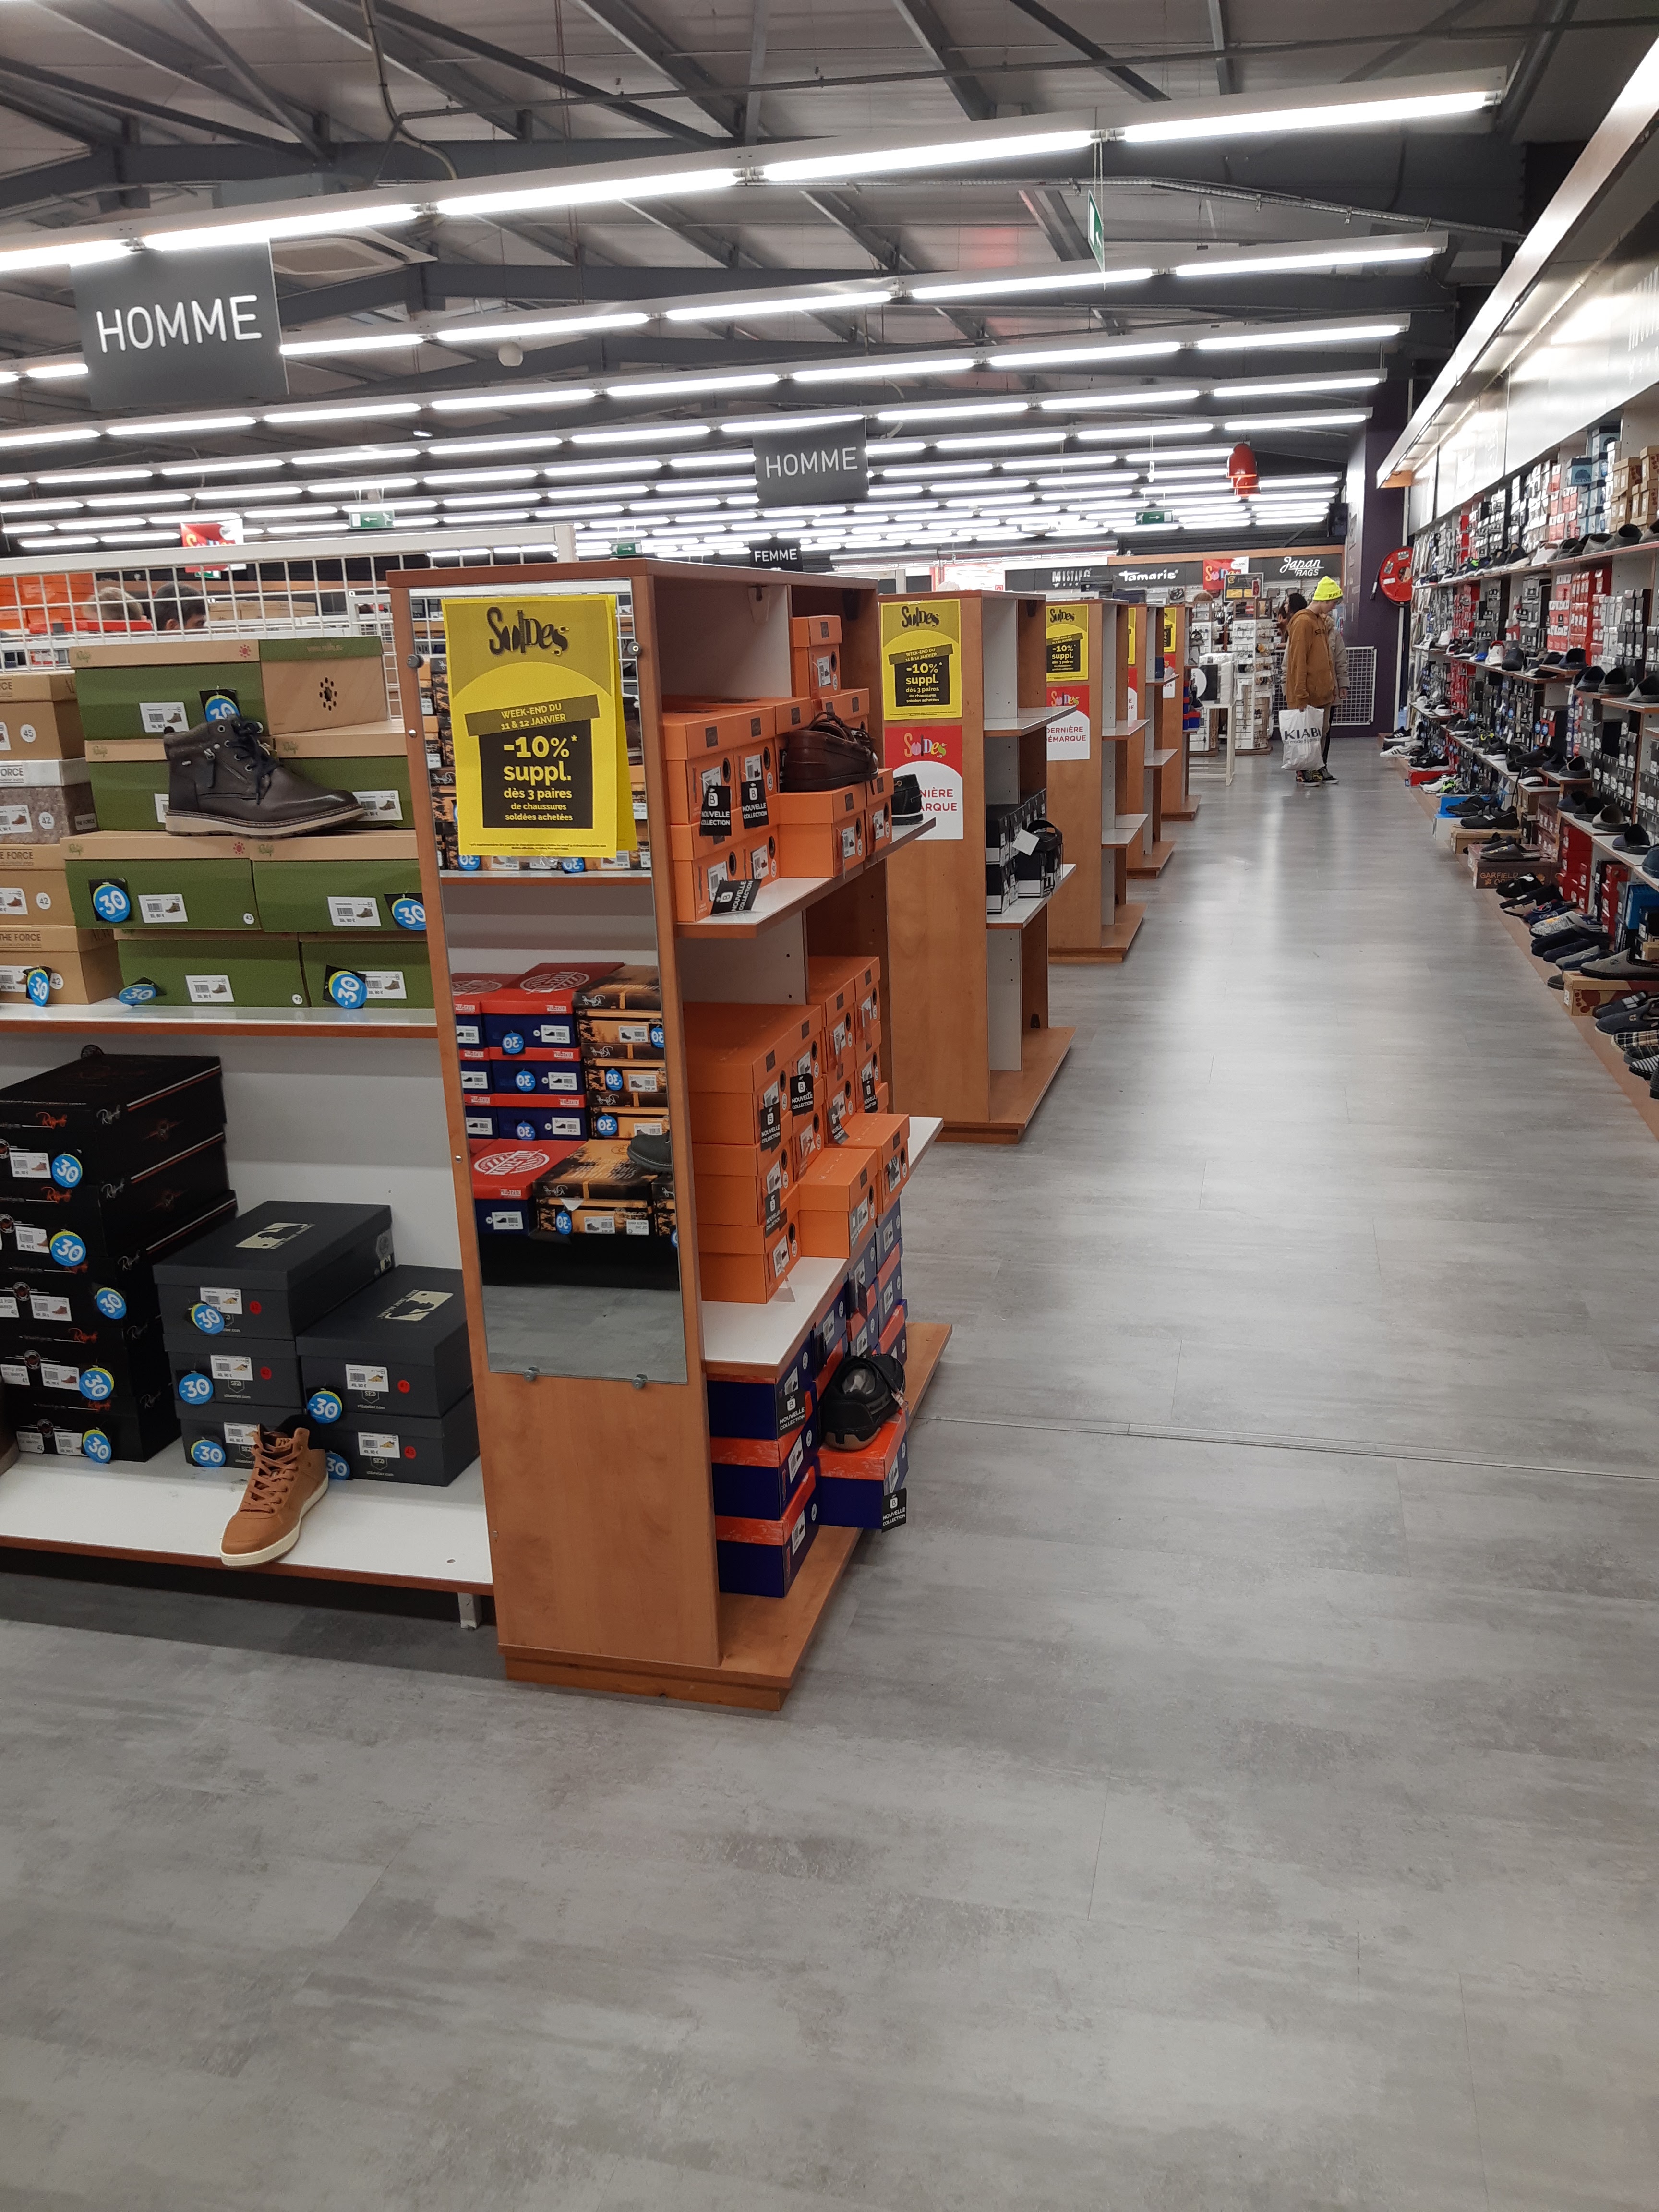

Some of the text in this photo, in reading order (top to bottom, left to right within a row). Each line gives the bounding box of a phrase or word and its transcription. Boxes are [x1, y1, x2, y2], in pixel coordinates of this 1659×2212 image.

[96, 294, 263, 353] HOMME
[765, 446, 858, 478] HOMME
[754, 548, 798, 562] FEMME
[1280, 556, 1323, 573] Japan
[1118, 569, 1177, 581] Tamaris
[905, 674, 939, 686] suppl.
[501, 703, 562, 719] WEEK-END DU
[531, 713, 567, 726] JANVIER
[1285, 727, 1321, 740] KIABI
[0, 768, 24, 777] ORCE
[504, 760, 572, 786] suppl.
[504, 787, 573, 801] dès 3 paires
[919, 787, 953, 798] NIÈRE
[523, 802, 567, 810] chaussures
[742, 802, 767, 812] NOUVELLE
[505, 813, 573, 821] soldées achetées
[743, 810, 768, 820] COLLECTION
[7, 852, 34, 860] FORCE
[15, 933, 42, 941] FORCE
[779, 1407, 805, 1425] NOUVELLE
[780, 1414, 805, 1431] COLLECTION
[882, 1506, 906, 1521] NOUVELLE
[882, 1514, 906, 1527] COLLECTION
